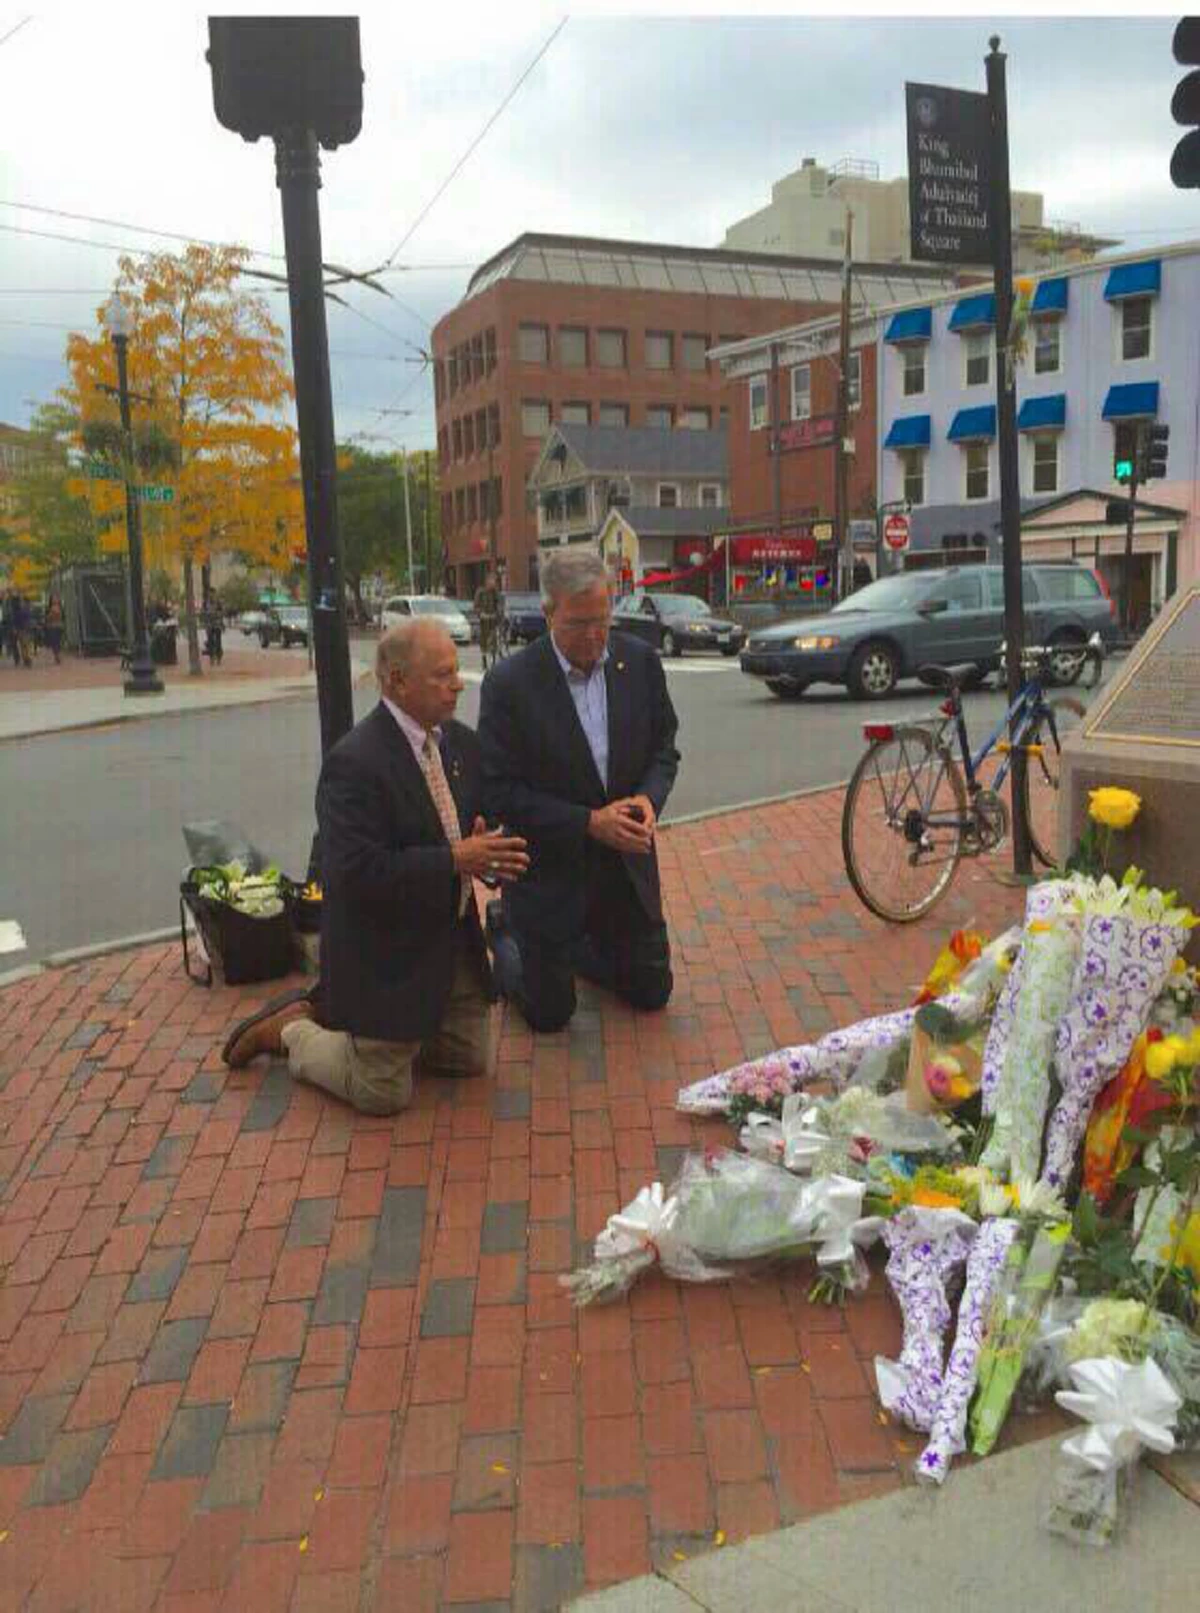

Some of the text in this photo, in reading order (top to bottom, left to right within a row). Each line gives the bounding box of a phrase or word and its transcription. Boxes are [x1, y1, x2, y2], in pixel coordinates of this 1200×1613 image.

[918, 134, 949, 158] King
[935, 207, 988, 230] Thailand
[920, 229, 961, 254] Square
